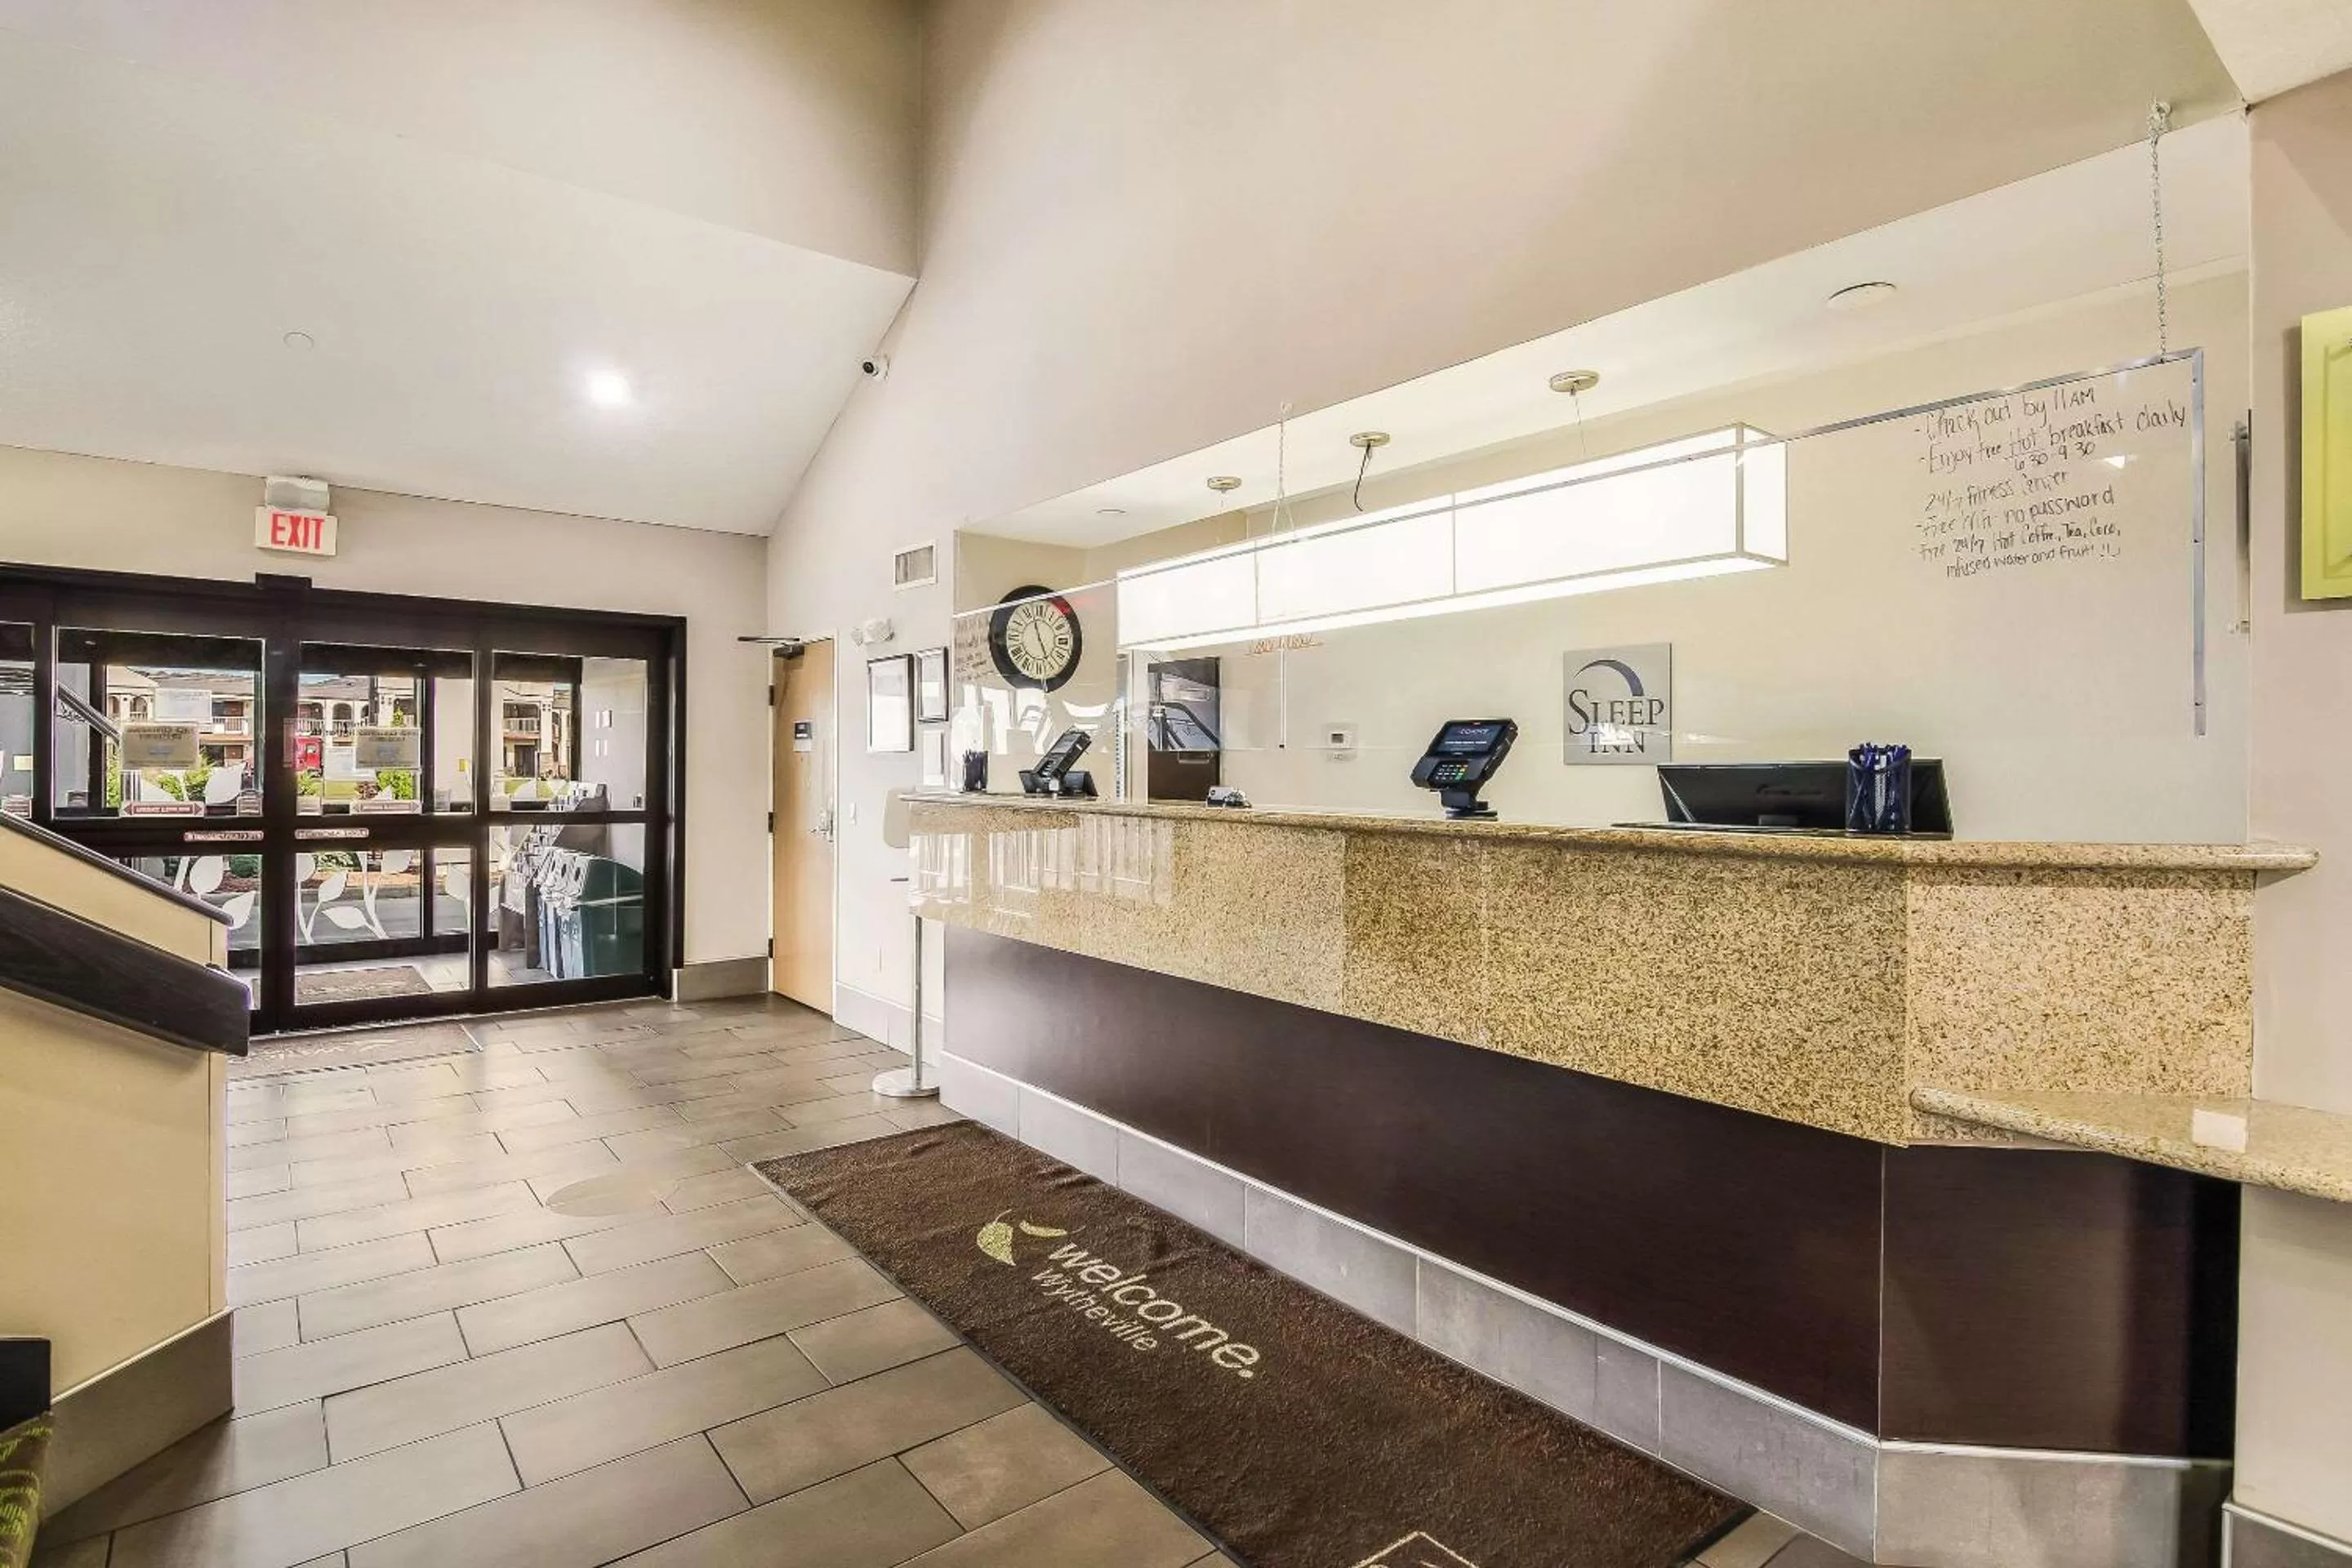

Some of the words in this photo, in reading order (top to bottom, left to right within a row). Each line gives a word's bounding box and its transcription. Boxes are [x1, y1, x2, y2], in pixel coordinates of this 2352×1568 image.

[1984, 399, 2011, 425] out
[2022, 394, 2048, 429] by
[1930, 442, 1971, 474] Enjoy
[2050, 411, 2124, 446] breakfast
[2136, 399, 2186, 432] daily
[2004, 508, 2025, 524] no
[2029, 483, 2114, 522] password
[270, 513, 325, 550] EXIT
[1952, 534, 1984, 555] 24/7
[1994, 552, 2029, 568] water
[2031, 548, 2056, 564] and
[1568, 689, 1664, 734] SLEEP
[1031, 1268, 1158, 1352] Wytheville
[1048, 1242, 1261, 1379] welcome.
